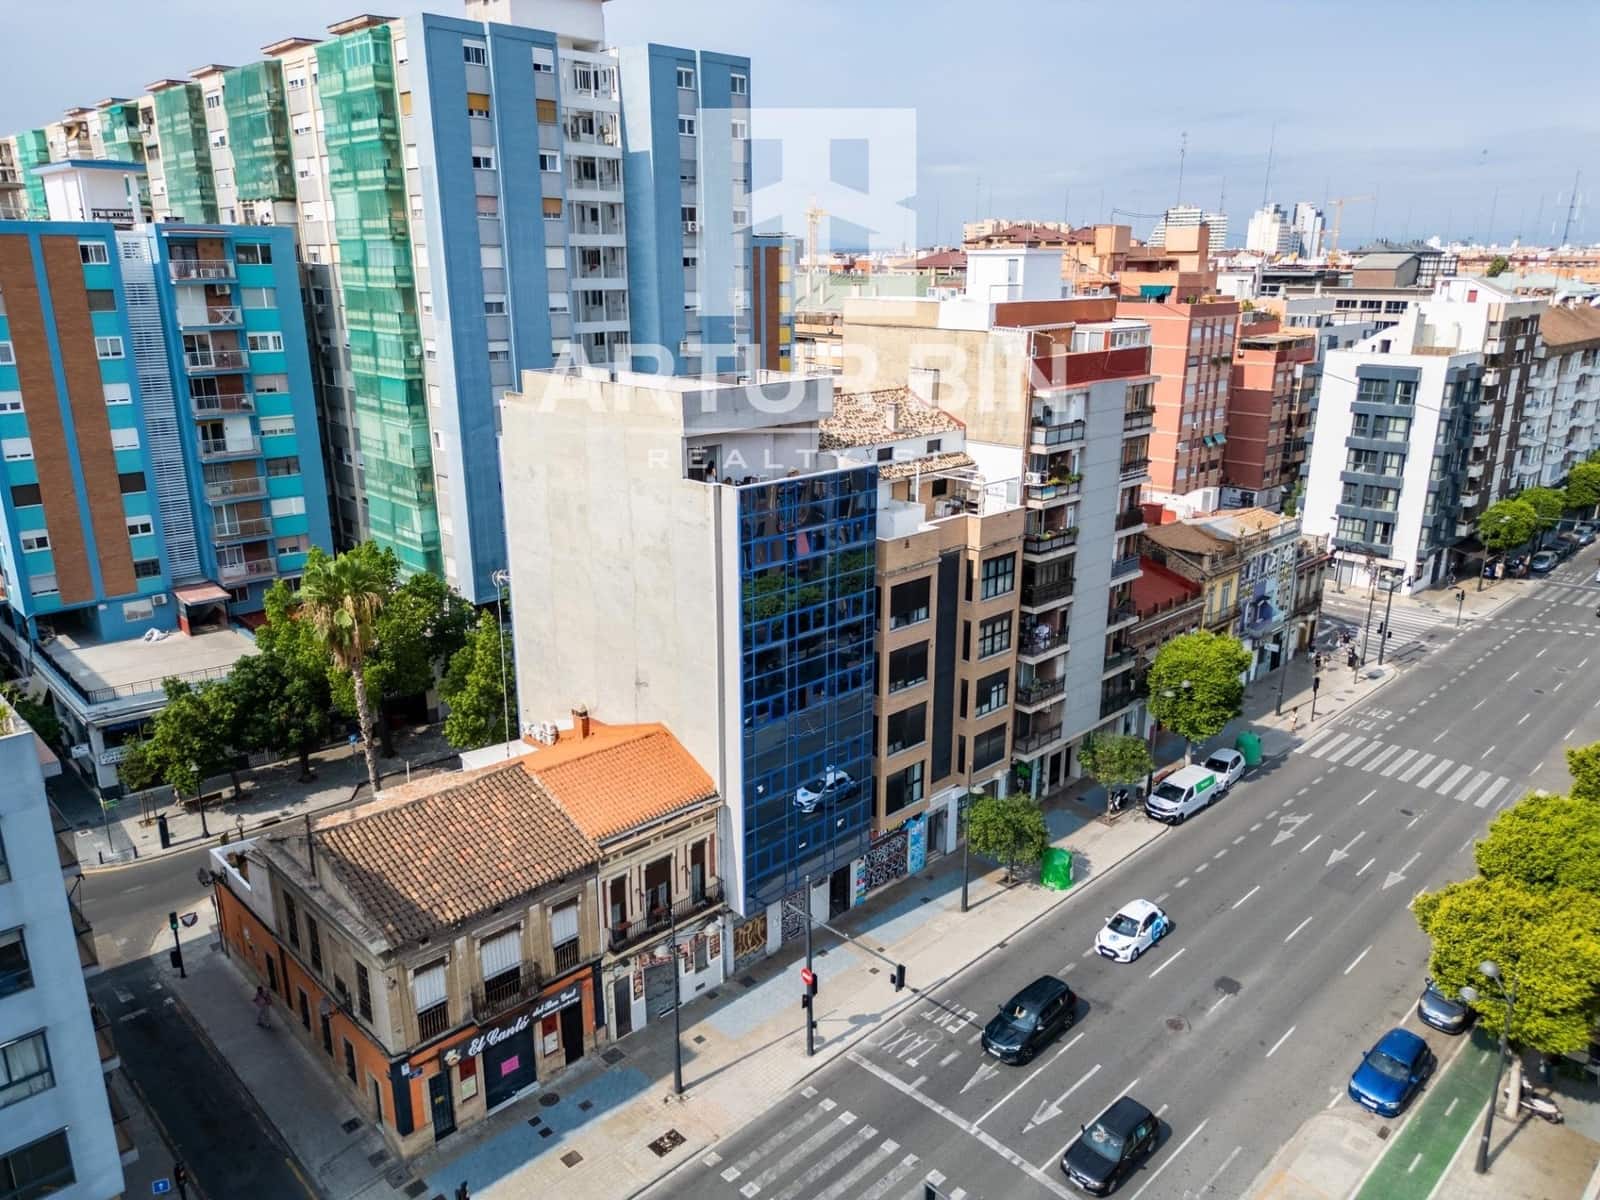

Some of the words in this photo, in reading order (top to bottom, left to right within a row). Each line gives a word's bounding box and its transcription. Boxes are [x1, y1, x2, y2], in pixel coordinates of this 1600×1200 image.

[920, 999, 979, 1034] EMT
[467, 1034, 486, 1057] El
[879, 1024, 937, 1068] TAXI
